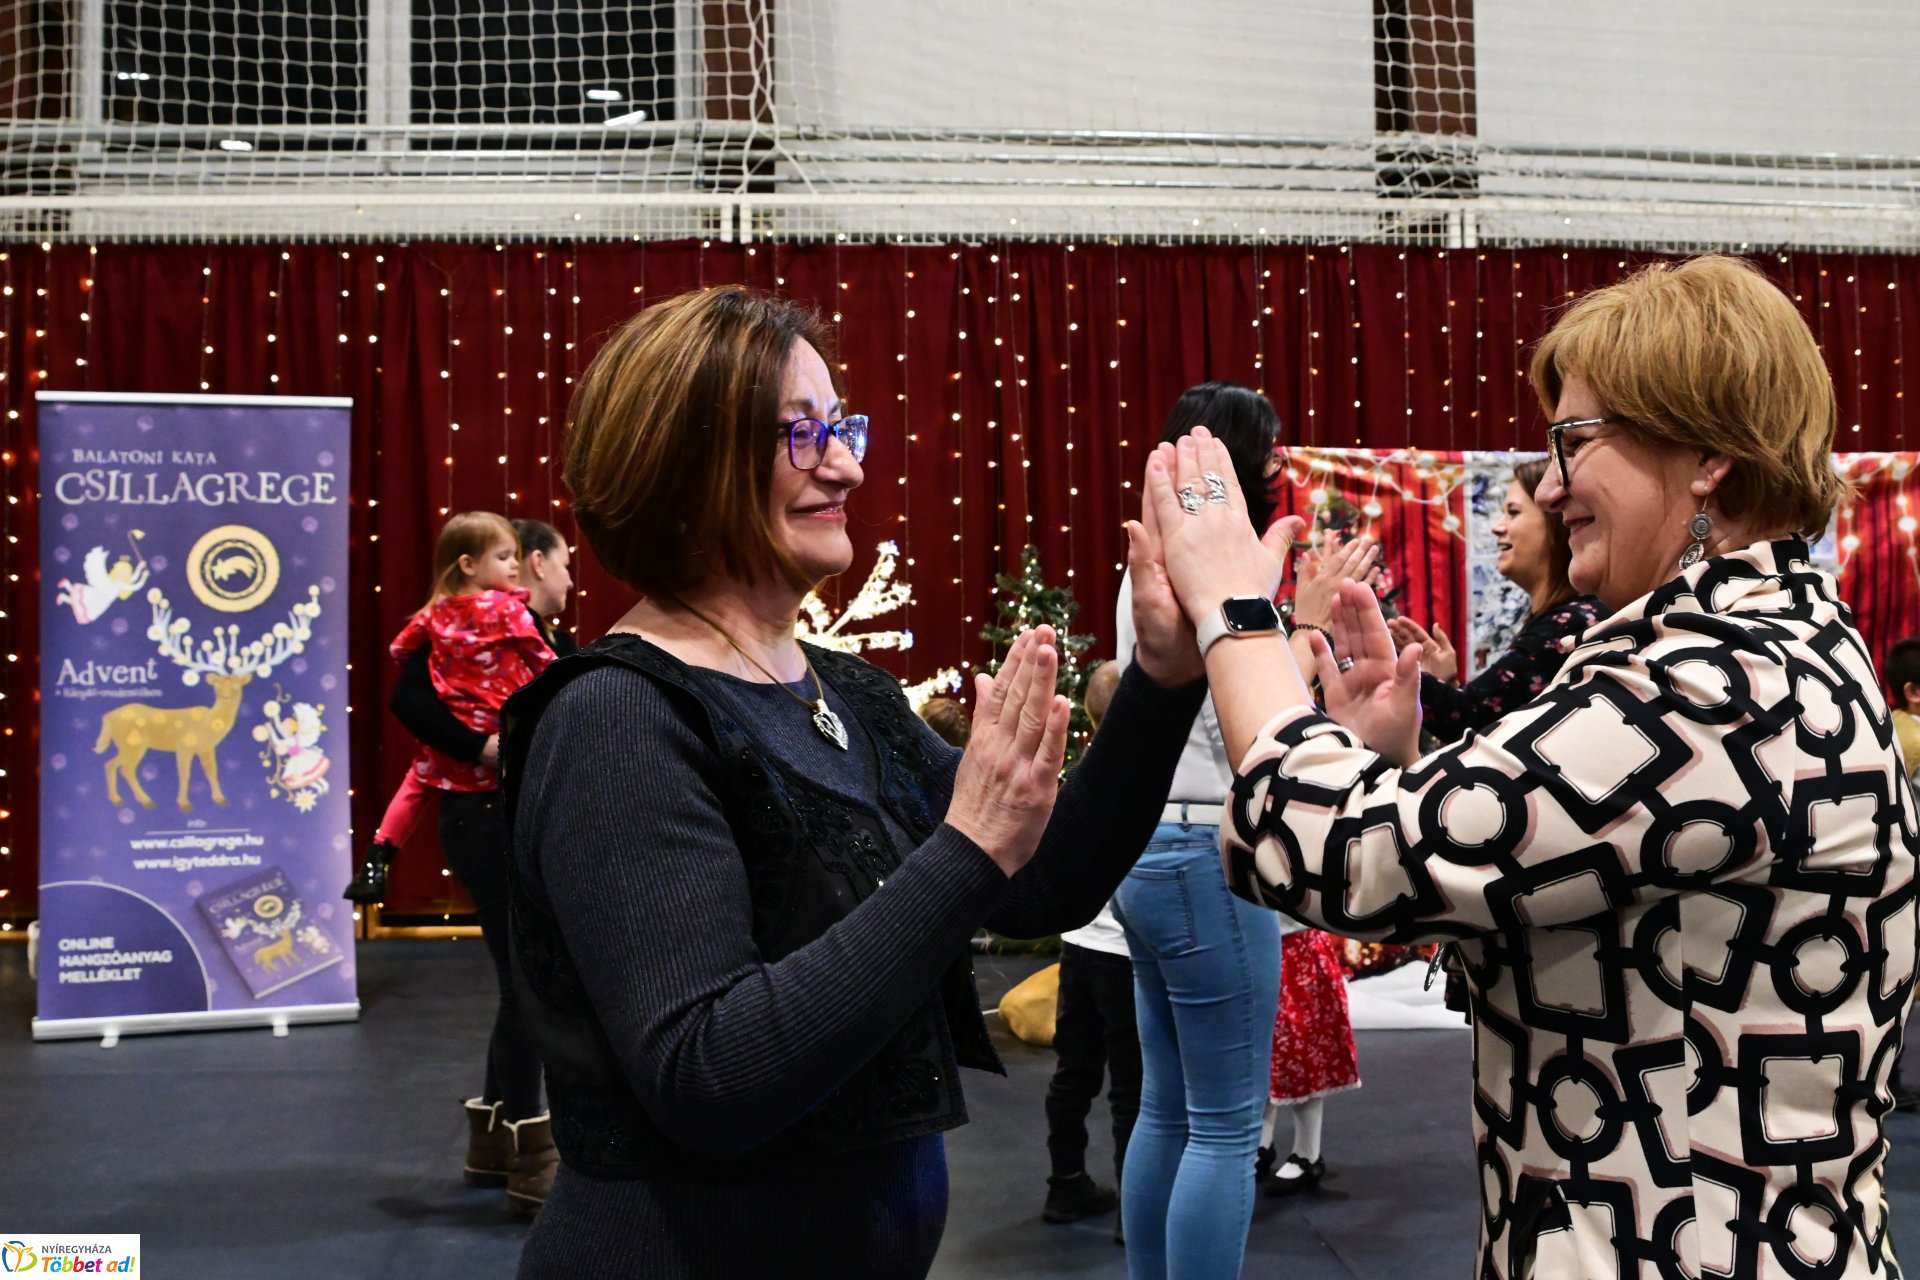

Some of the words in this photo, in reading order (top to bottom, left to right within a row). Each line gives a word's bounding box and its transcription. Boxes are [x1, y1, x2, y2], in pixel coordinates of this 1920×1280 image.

[72, 450, 162, 464] BALATONI
[172, 452, 217, 465] KATA
[55, 469, 337, 505] CSILLAGREGE
[56, 659, 158, 685] Advent
[58, 937, 115, 950] ONLINE
